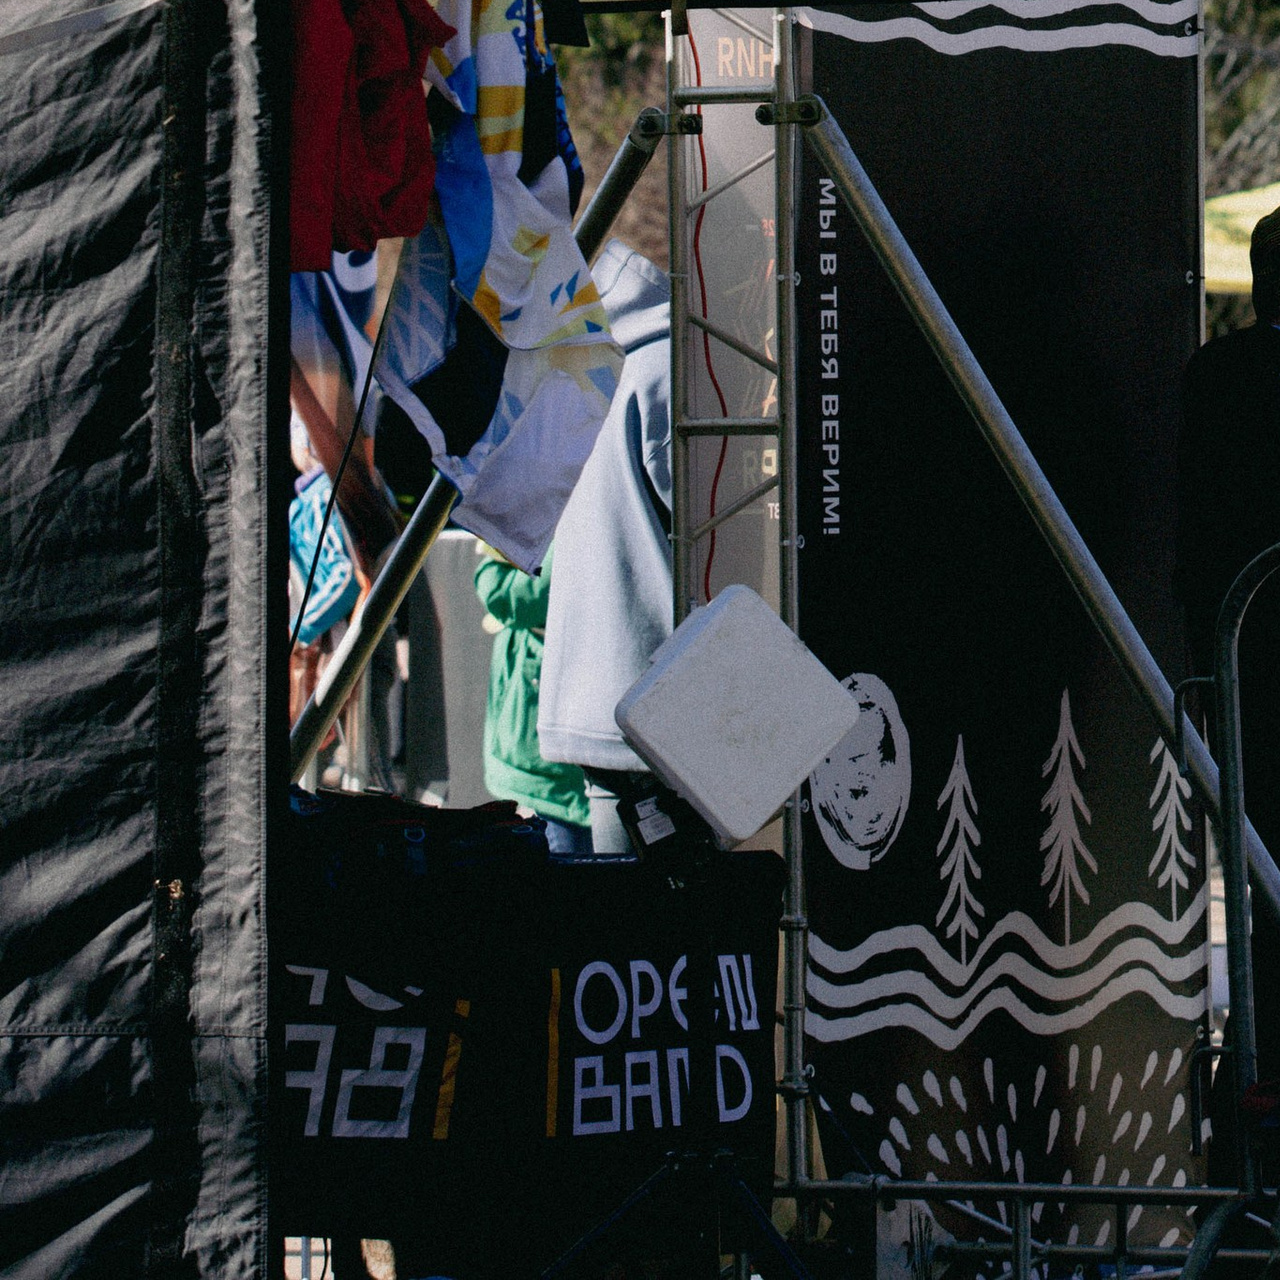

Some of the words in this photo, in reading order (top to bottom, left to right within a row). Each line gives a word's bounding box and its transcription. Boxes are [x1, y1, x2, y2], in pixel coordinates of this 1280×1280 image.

[819, 178, 837, 238] МЫ
[820, 253, 837, 276] В
[820, 286, 839, 379] ТЕБЯ
[822, 394, 840, 534] ВЕРИМ!
